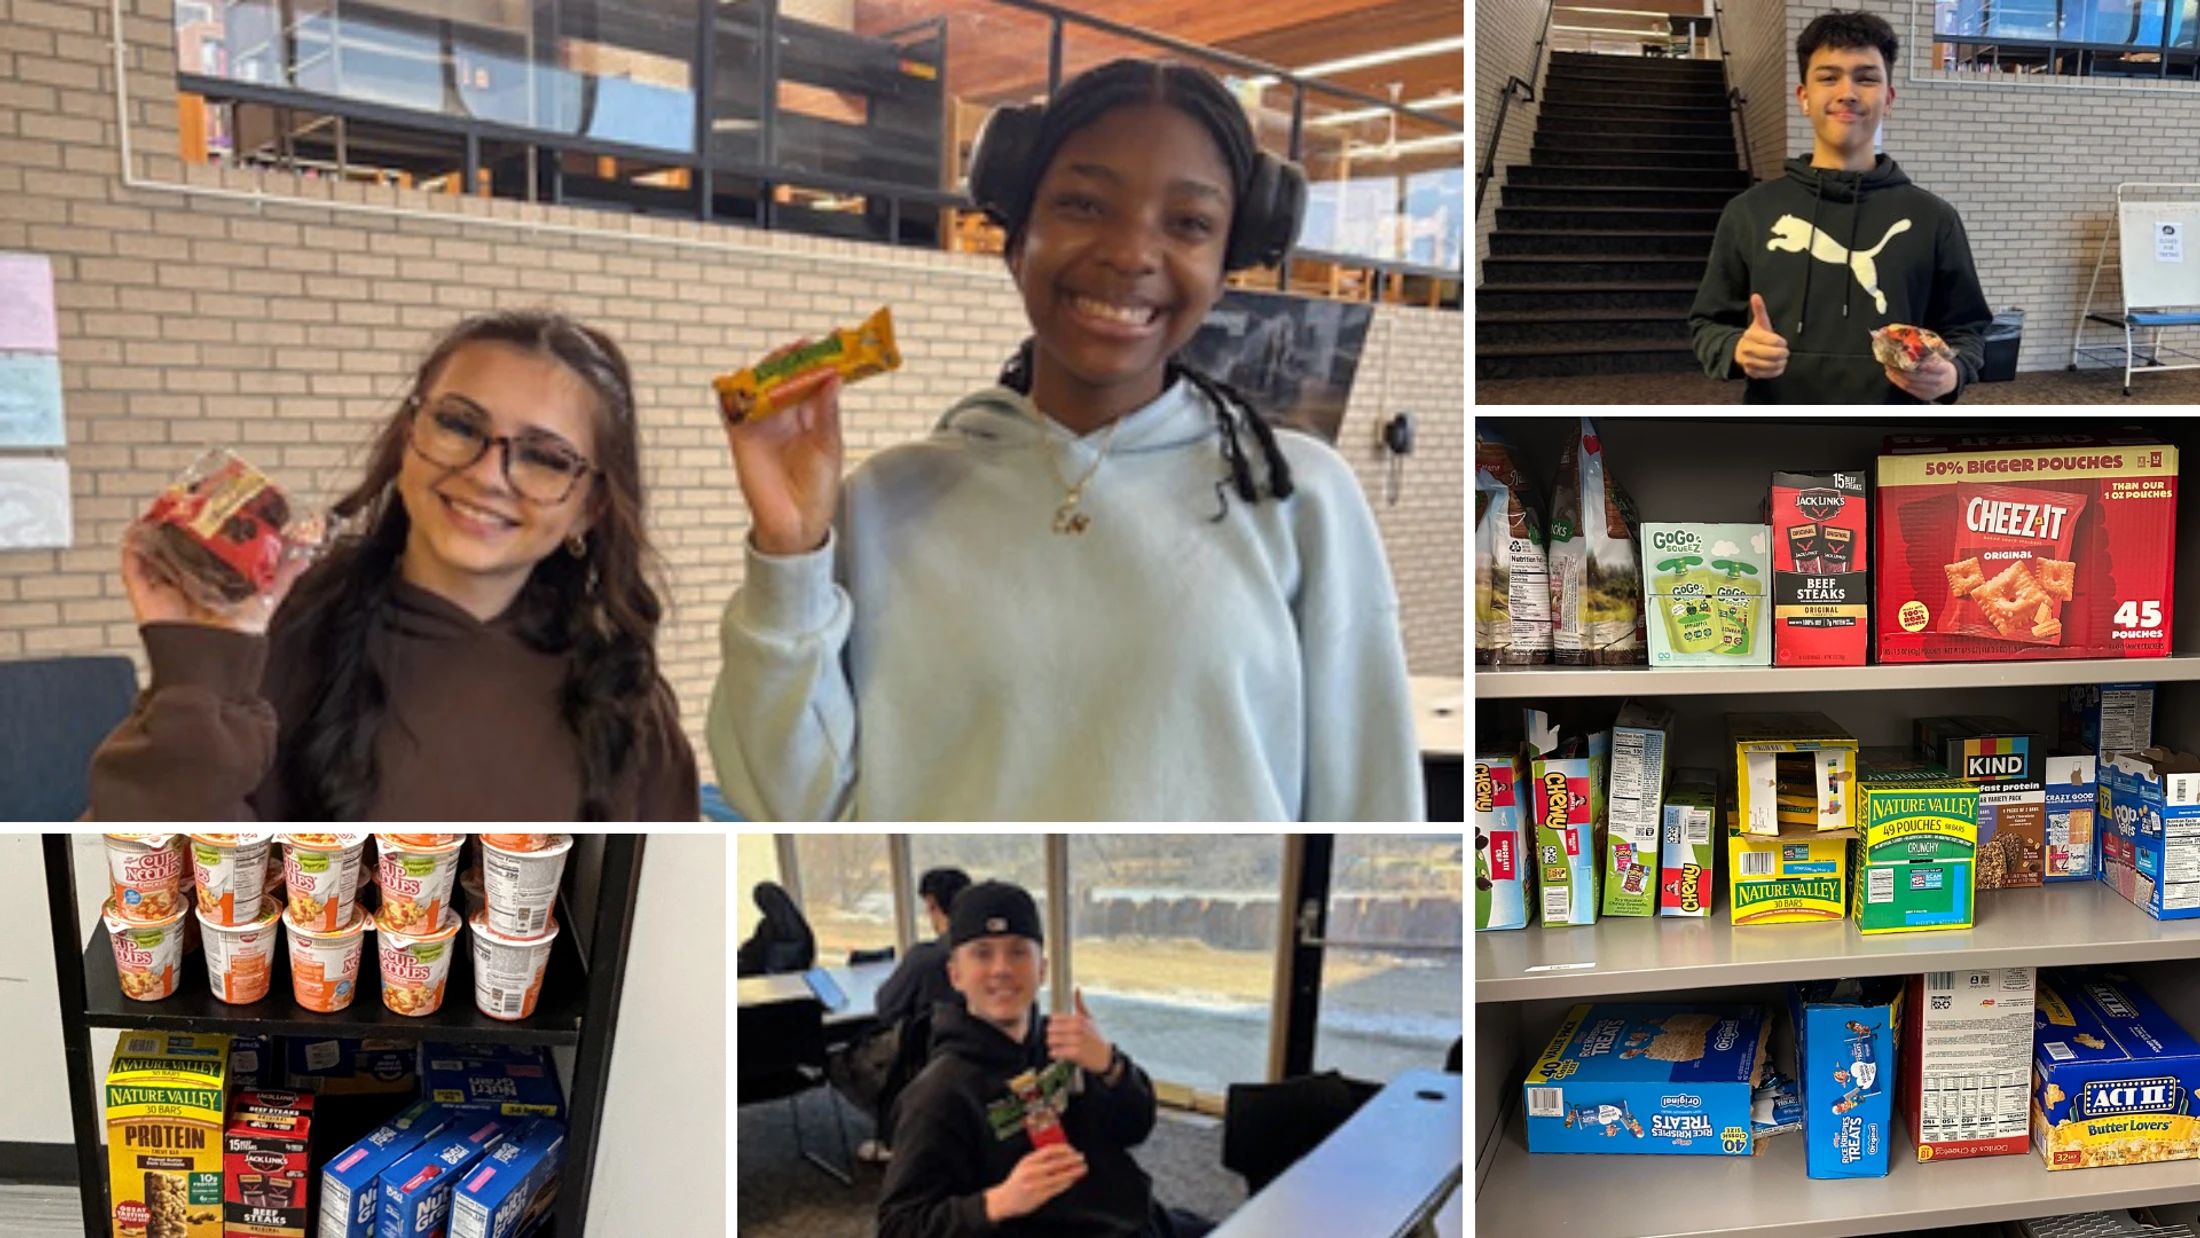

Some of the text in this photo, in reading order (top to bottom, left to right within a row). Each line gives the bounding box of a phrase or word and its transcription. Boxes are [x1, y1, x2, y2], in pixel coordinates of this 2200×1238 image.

[1926, 461, 1964, 476] 50%
[1833, 473, 1844, 488] 15
[2142, 482, 2164, 490] OUR
[1796, 496, 1818, 506] JACK
[1807, 578, 1836, 588] BEEF
[1797, 589, 1846, 599] STEAKS
[1904, 610, 1924, 618] 100%
[2114, 600, 2162, 628] 45
[1970, 756, 2023, 775] KIND
[2003, 782, 2040, 792] protein
[1872, 798, 1976, 821] NATURE VALLEY
[2101, 794, 2110, 812] 12
[1884, 824, 1895, 836] 49
[1897, 820, 1941, 833] POUCHES
[1502, 840, 1510, 871] CHOCOLATE
[1908, 842, 1939, 853] CRUNCHY
[139, 852, 174, 868] CUP
[1739, 882, 1837, 906] NATURE VALLEY
[385, 948, 419, 965] CUP
[1592, 1020, 1624, 1056] TREATS
[1717, 1021, 1738, 1050] Original
[117, 1058, 218, 1077] NATURE VALLEY
[1540, 1062, 1561, 1078] 40
[110, 1088, 217, 1110] NATURE VALLEY
[1664, 1096, 1699, 1106] Original
[2094, 1086, 2165, 1108] ACT II
[146, 1106, 182, 1115] 30 BARS
[269, 1108, 299, 1116] STEAKS
[1652, 1115, 1711, 1129] TREATS
[2088, 1122, 2128, 1136] Butter
[2130, 1120, 2169, 1131] Lovers
[125, 1125, 205, 1149] PROTEIN
[1652, 1128, 1713, 1138] RICE KRISPIES
[1840, 1116, 1850, 1147] KRISPIES
[229, 1139, 240, 1151] 15
[1724, 1139, 1746, 1152] 40
[1849, 1118, 1862, 1162] TREATS
[200, 1174, 217, 1183] 10g
[244, 1214, 287, 1224] STEAKS
